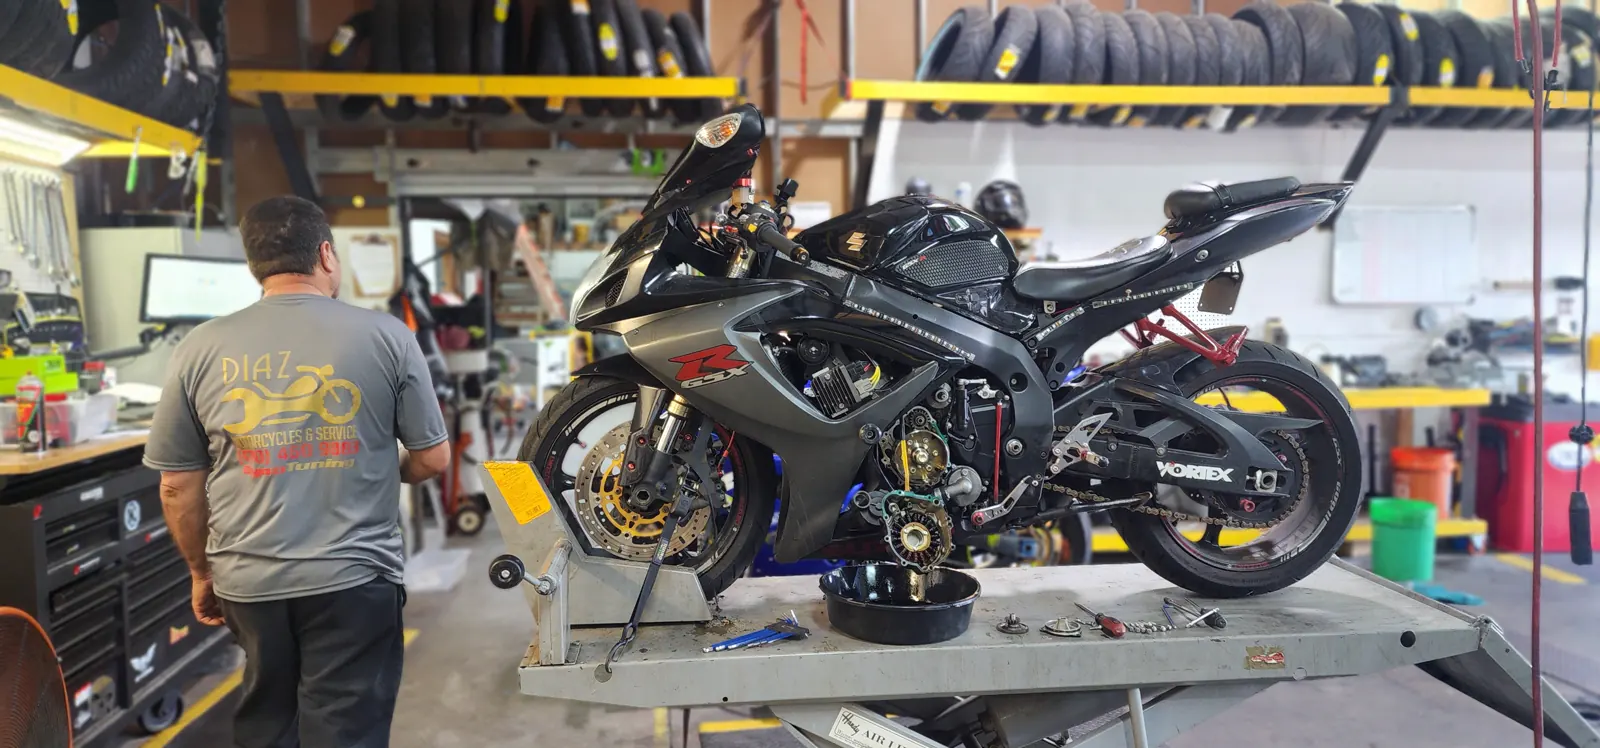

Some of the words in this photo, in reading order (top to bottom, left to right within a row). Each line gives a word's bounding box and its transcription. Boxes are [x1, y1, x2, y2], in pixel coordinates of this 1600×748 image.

[221, 350, 292, 385] DIAZ
[668, 344, 751, 382] R
[680, 361, 753, 389] GSX
[232, 428, 303, 449] ORCYCLES
[1156, 460, 1235, 483] VORTEX
[841, 710, 861, 737] Handy
[860, 729, 886, 745] AIR
